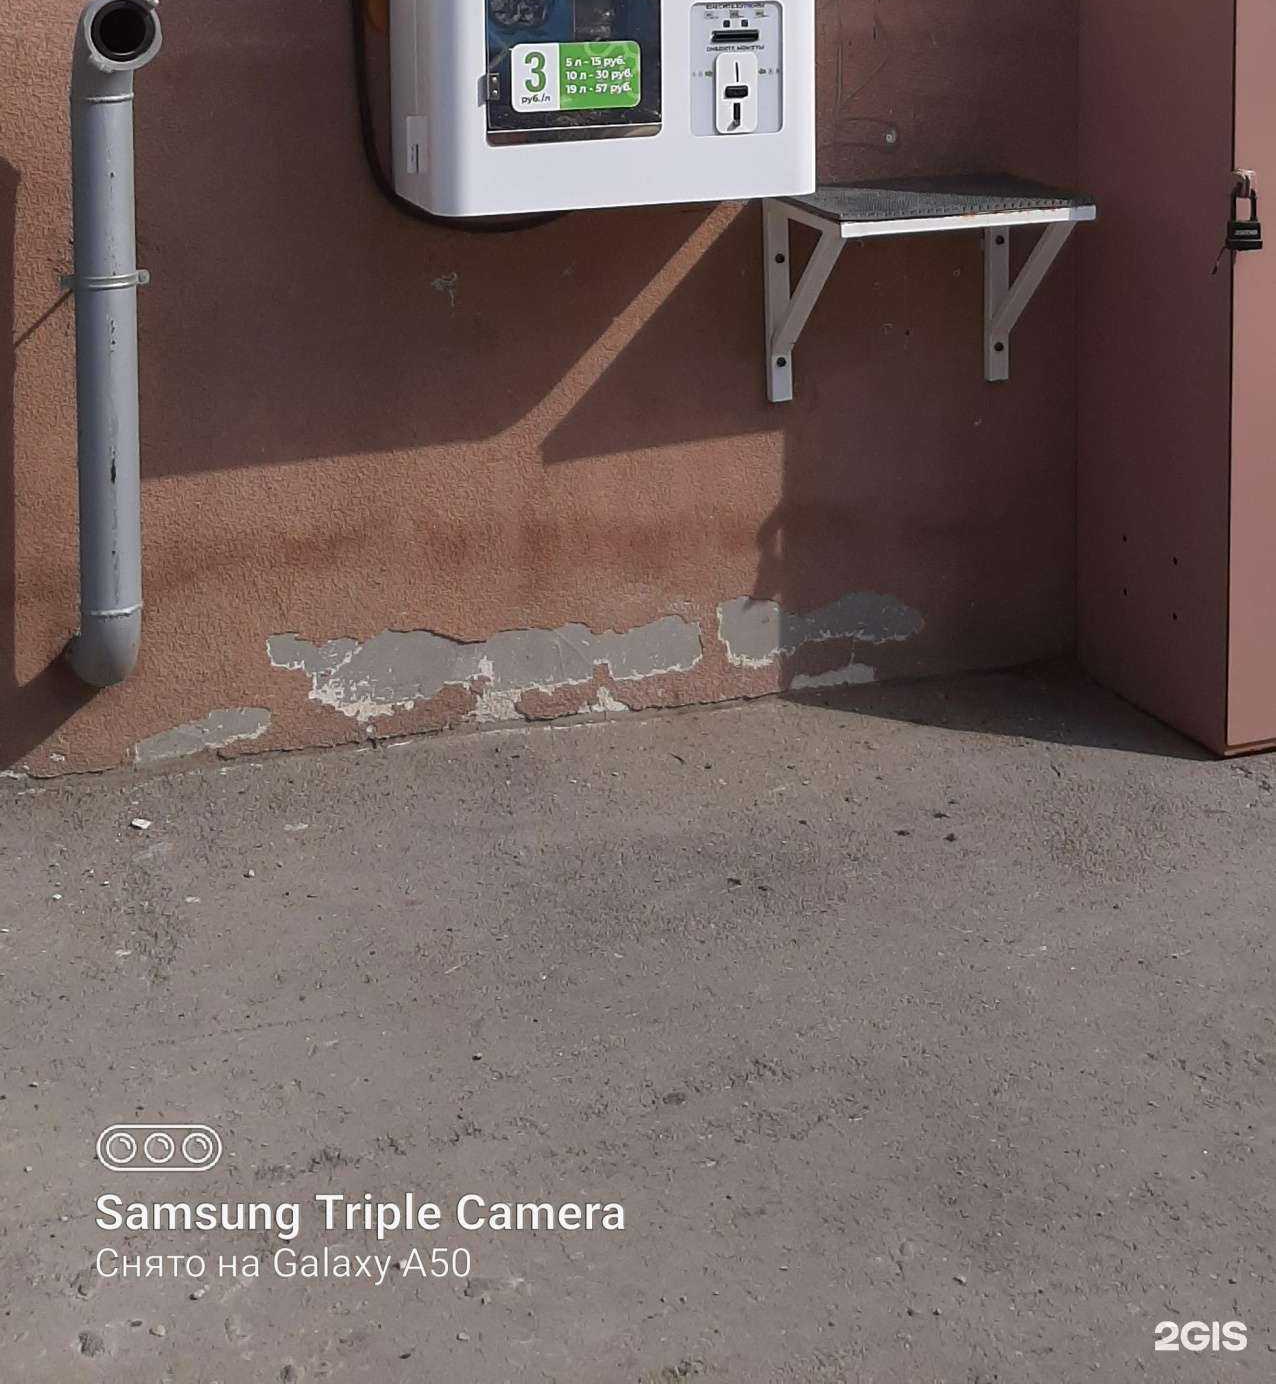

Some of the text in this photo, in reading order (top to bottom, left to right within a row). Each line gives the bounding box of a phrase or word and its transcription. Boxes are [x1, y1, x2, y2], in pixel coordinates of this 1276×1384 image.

[566, 58, 573, 67] 5
[591, 57, 602, 66] 15
[603, 56, 626, 68] руб.
[525, 51, 546, 93] 3
[566, 71, 578, 80] 10
[595, 70, 609, 79] 30
[611, 68, 634, 80] руб.
[566, 85, 577, 94] 19
[595, 84, 608, 92] 57
[610, 82, 632, 94] руб.
[521, 93, 551, 104] руб./л
